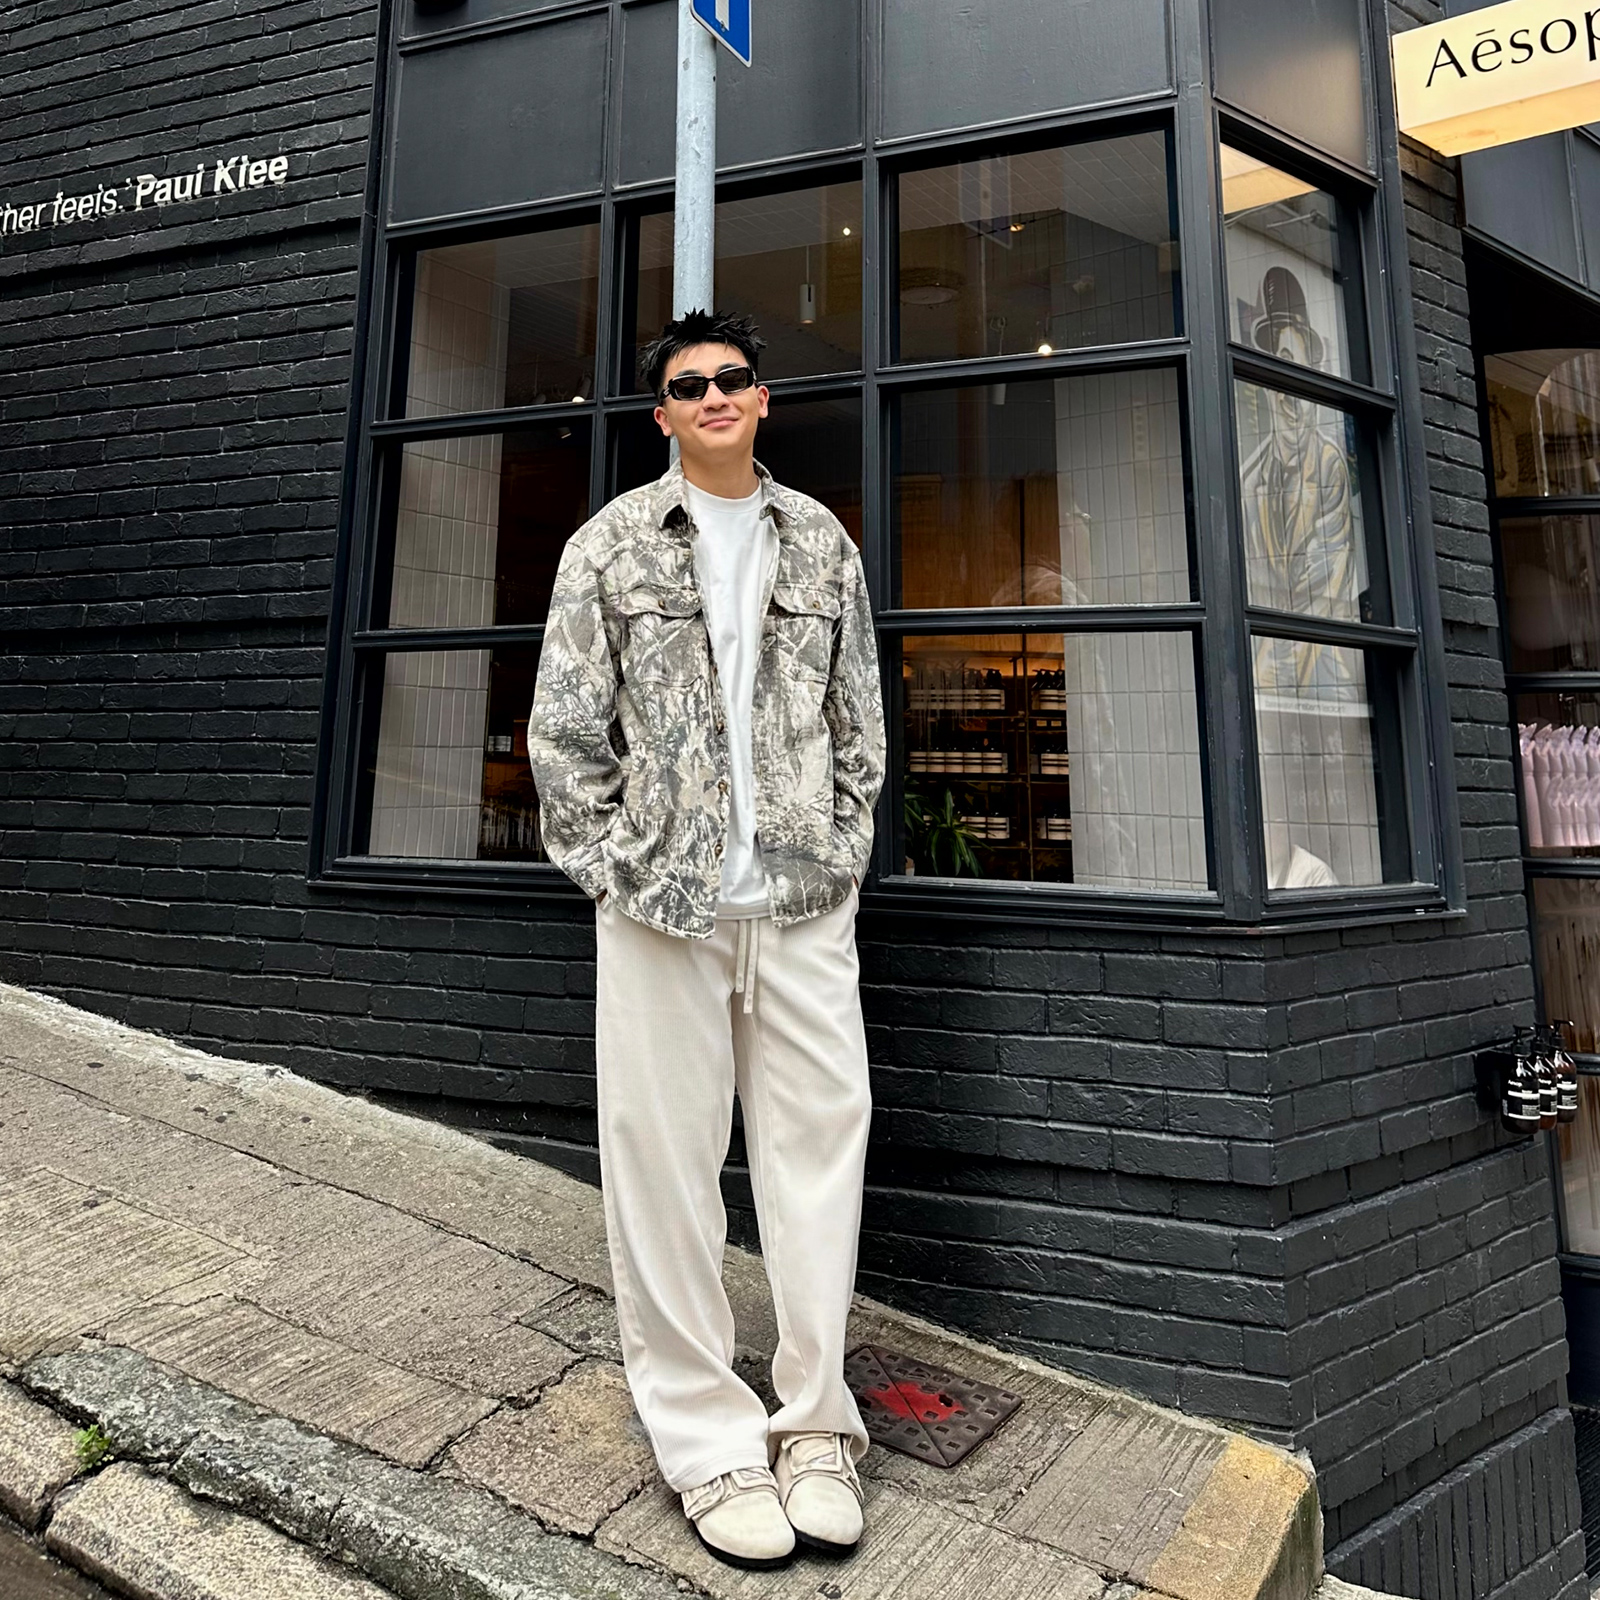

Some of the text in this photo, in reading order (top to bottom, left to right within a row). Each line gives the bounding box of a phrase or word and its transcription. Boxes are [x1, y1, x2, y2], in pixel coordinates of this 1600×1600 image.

[0, 203, 47, 236] her
[135, 164, 204, 212] Paul
[213, 154, 289, 195] Klee
